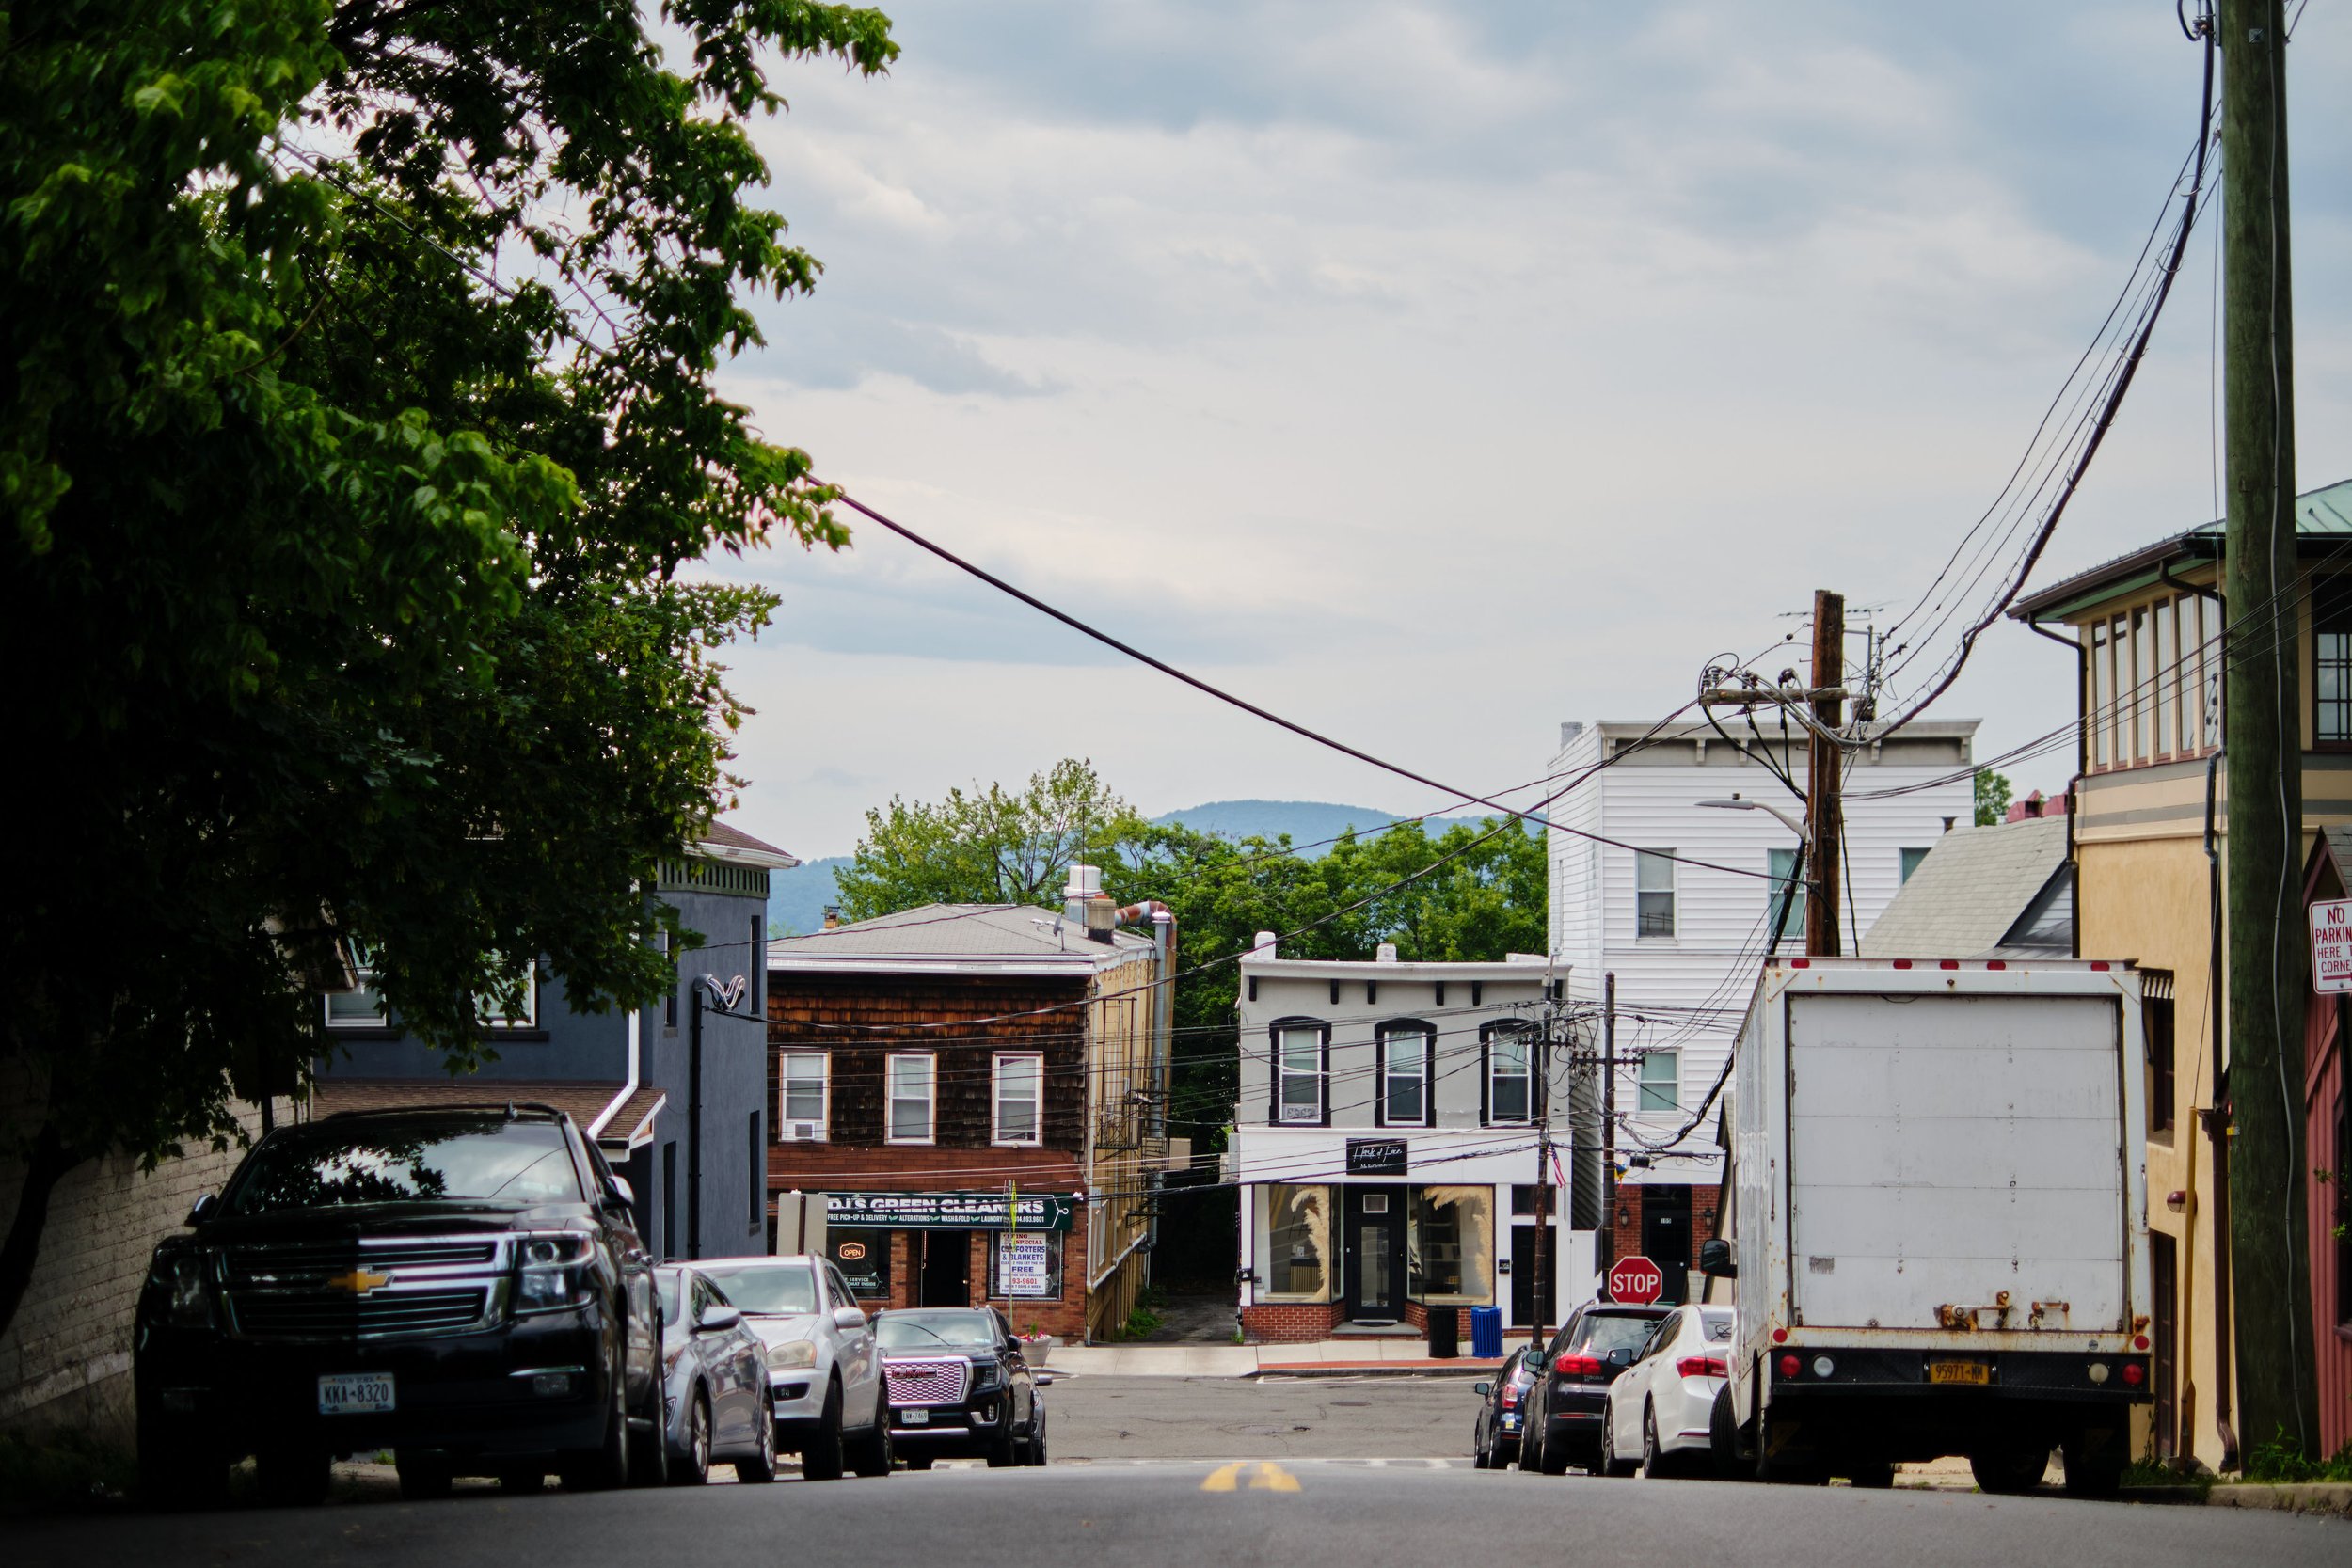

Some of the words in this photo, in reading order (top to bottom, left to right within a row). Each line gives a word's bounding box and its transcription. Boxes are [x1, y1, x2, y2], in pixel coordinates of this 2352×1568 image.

[2328, 907, 2345, 925] NO
[2315, 926, 2352, 945] PARKIN
[2317, 946, 2341, 958] HERE
[2321, 959, 2352, 973] CORNE
[870, 1198, 936, 1212] GREEN
[941, 1199, 1044, 1213] CLEANRS
[1613, 1273, 1659, 1293] STOP
[893, 1369, 936, 1378] GMC
